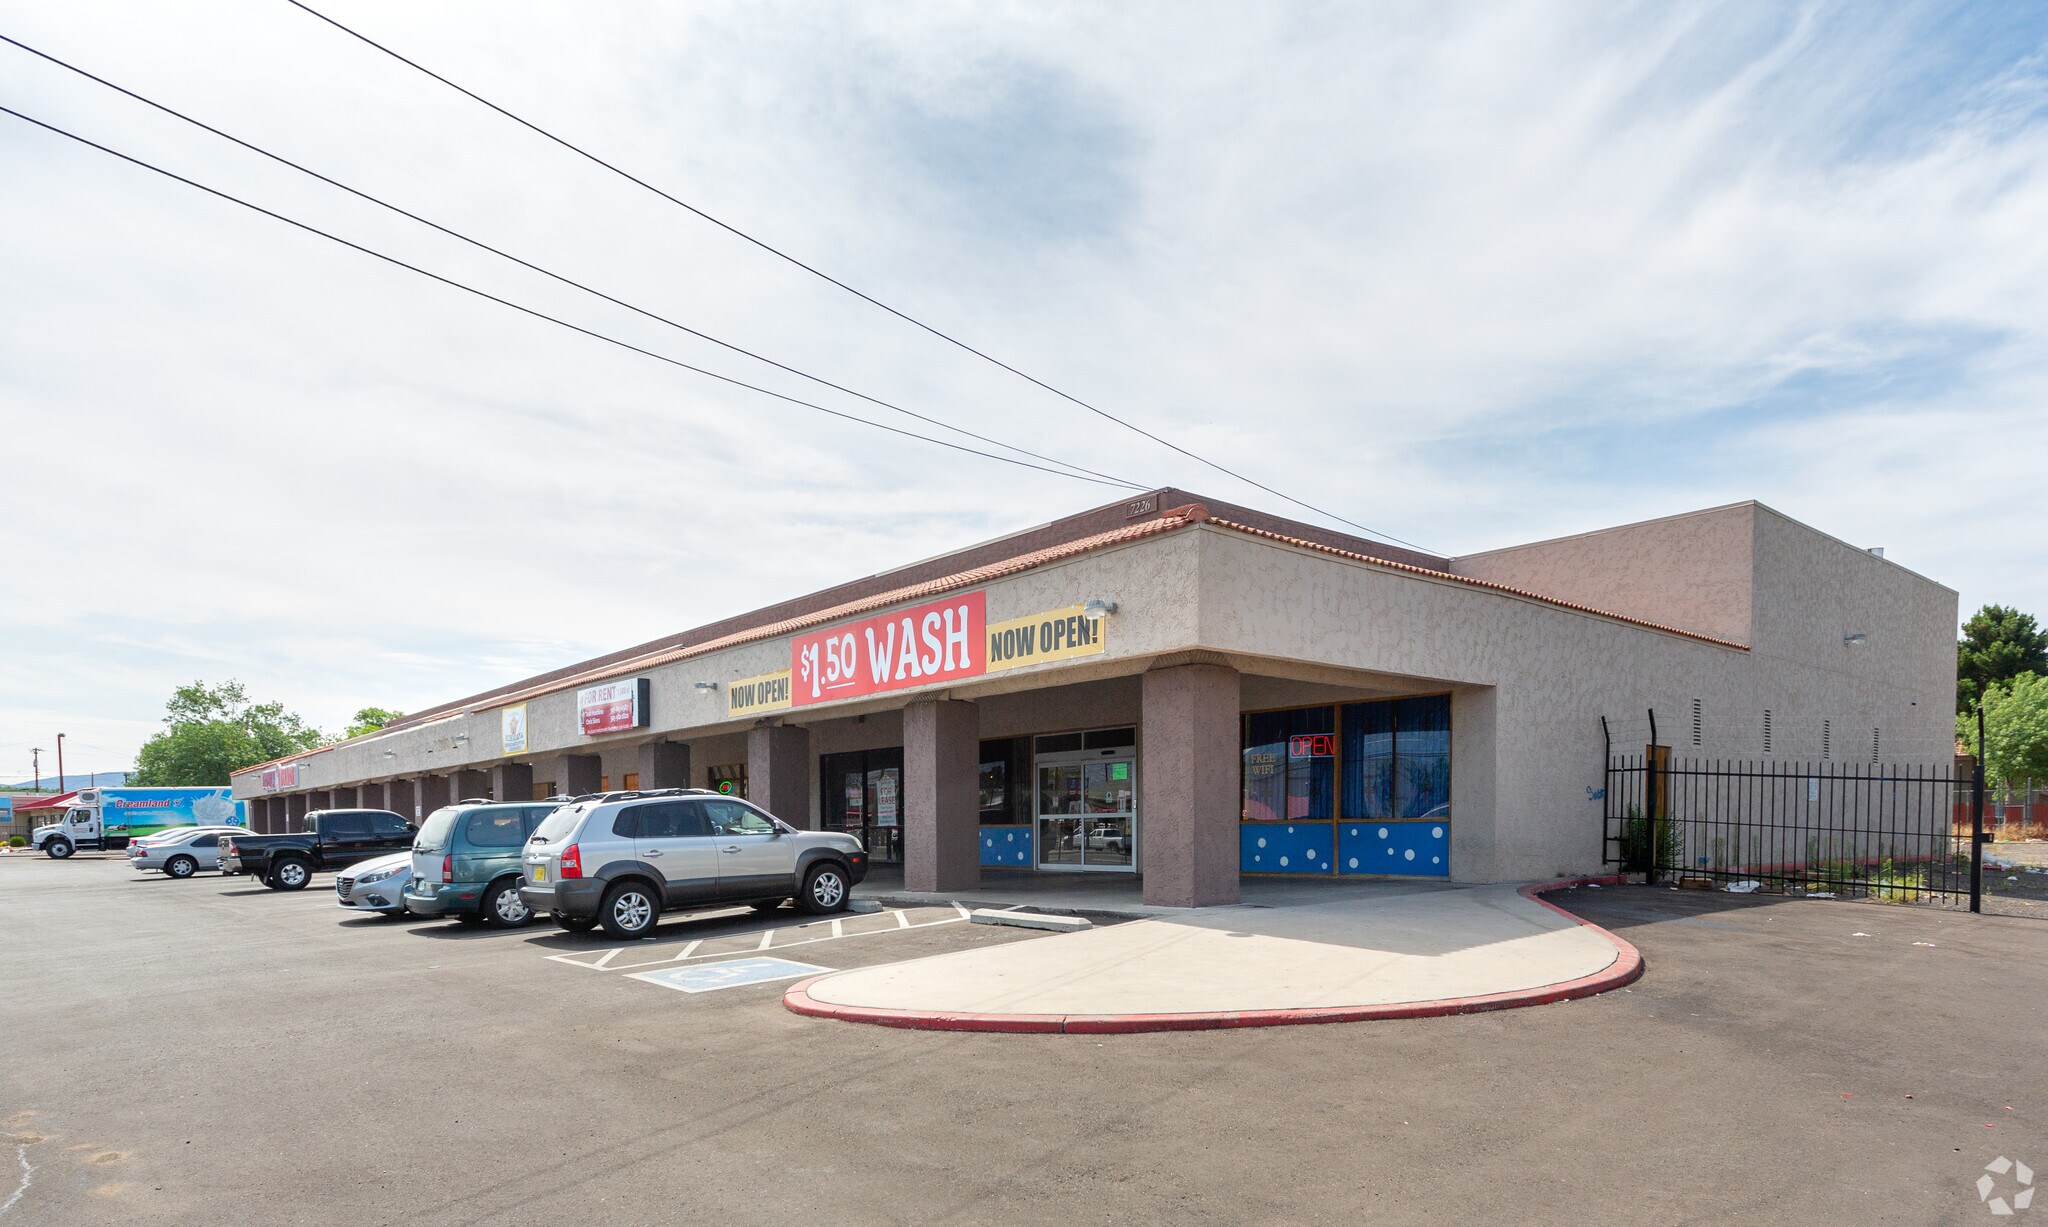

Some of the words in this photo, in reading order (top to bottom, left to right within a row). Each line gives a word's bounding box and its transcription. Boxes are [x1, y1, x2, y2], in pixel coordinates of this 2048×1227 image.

[1130, 499, 1151, 515] 7226
[991, 625, 1036, 662] NOW
[1040, 615, 1098, 653] OPEN!
[801, 633, 857, 698] $1.50
[865, 605, 971, 685] WASH
[584, 690, 596, 704] FOR
[598, 686, 616, 701] RENT
[731, 684, 755, 709] NOW
[758, 677, 788, 705] OPEN!
[1291, 735, 1335, 756] OPEN
[1251, 754, 1276, 763] FREE
[1252, 765, 1274, 775] WIFI
[115, 799, 171, 808] Creamland
[879, 796, 895, 805] LEASE
